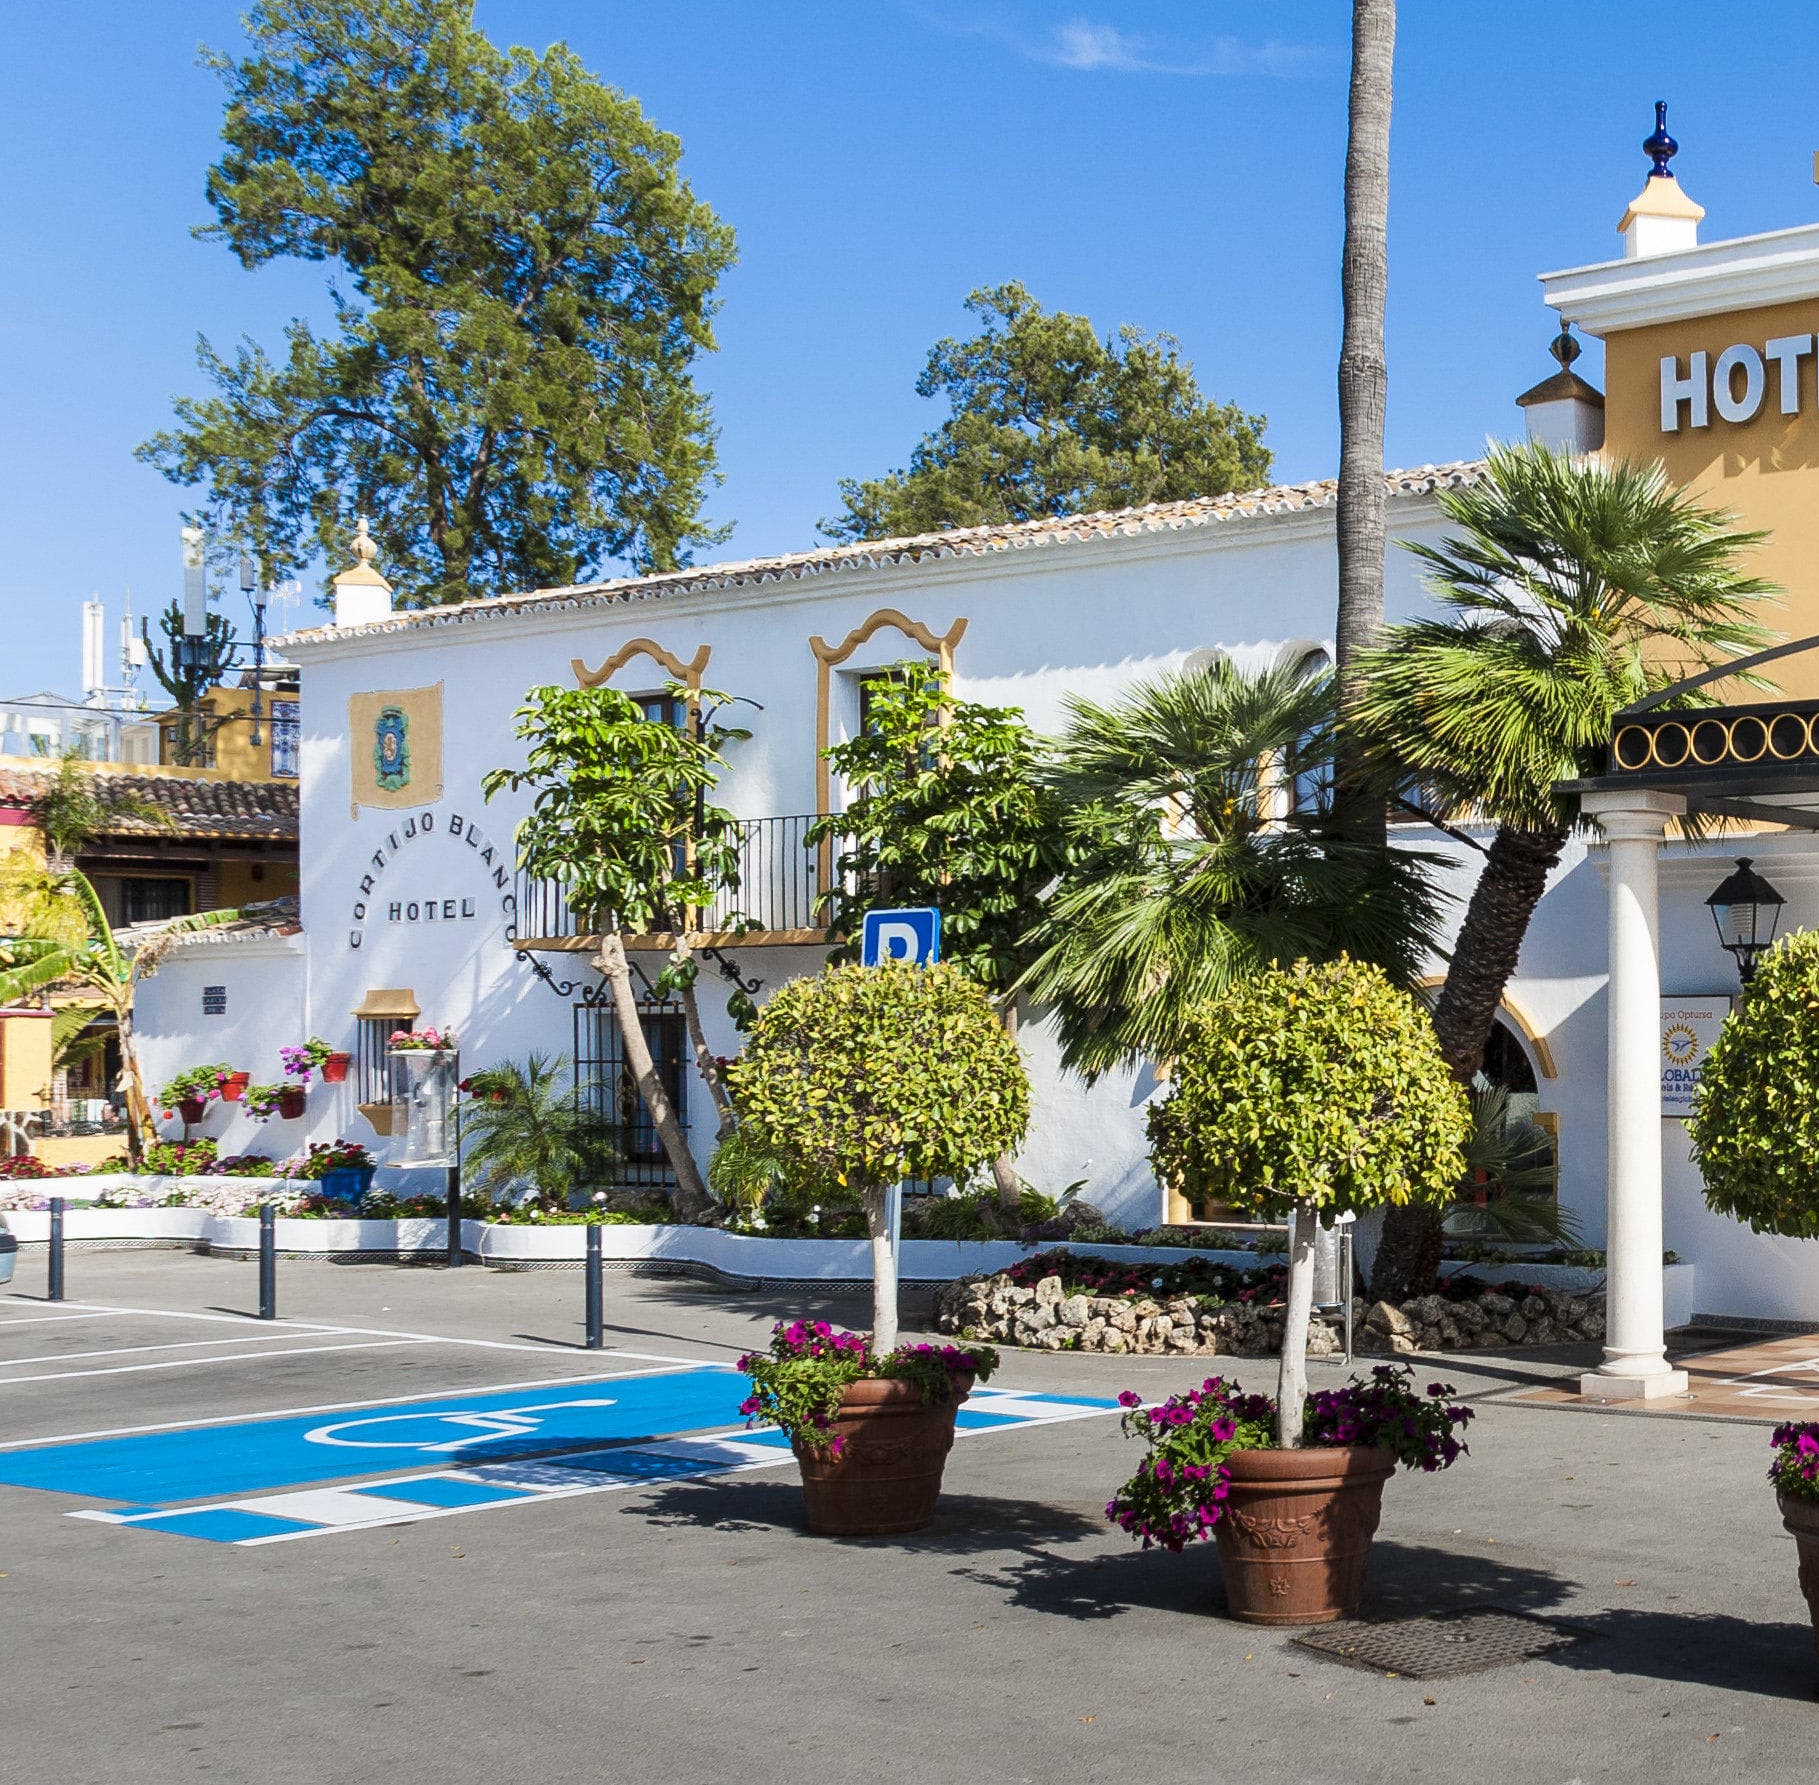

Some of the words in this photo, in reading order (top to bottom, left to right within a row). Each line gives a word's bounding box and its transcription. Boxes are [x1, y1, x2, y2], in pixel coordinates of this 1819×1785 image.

[350, 812, 433, 948] CORTIJO
[449, 814, 518, 943] BLANCO
[389, 899, 476, 921] HOTEL
